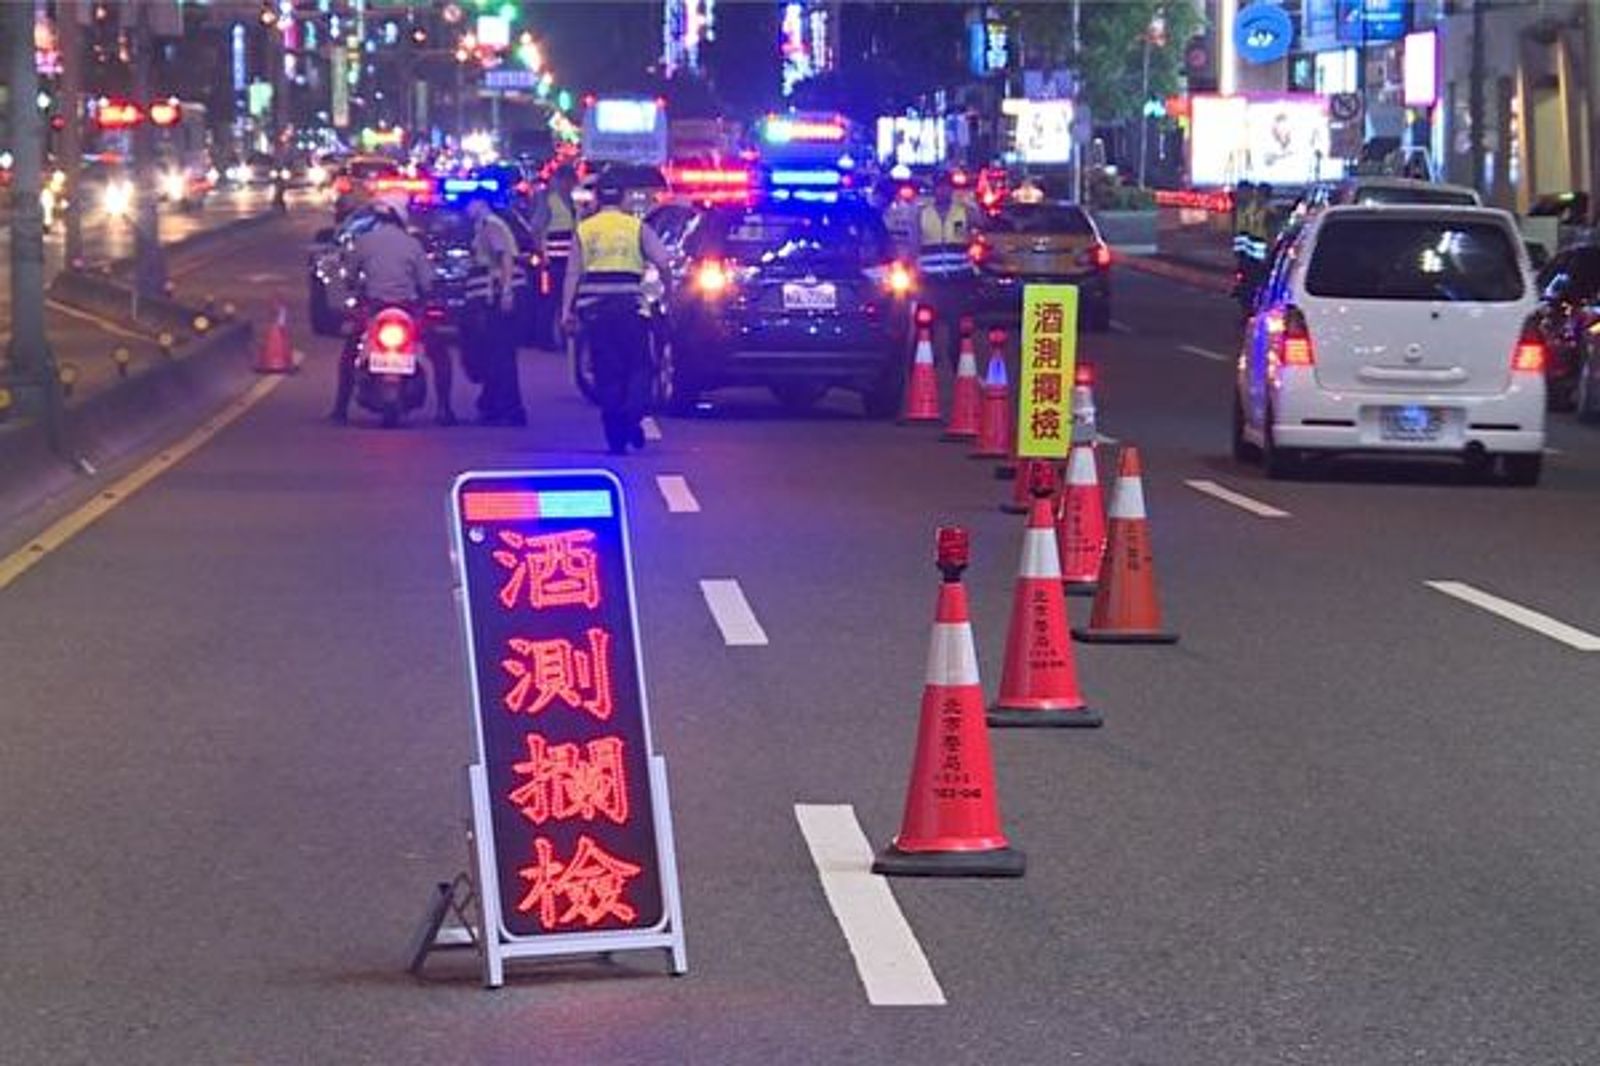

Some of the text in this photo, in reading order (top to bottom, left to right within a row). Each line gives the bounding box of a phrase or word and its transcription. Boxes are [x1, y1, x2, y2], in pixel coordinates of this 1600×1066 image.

[1031, 302, 1064, 440] 酒測攔檢
[493, 528, 641, 929] 酒測攔檢
